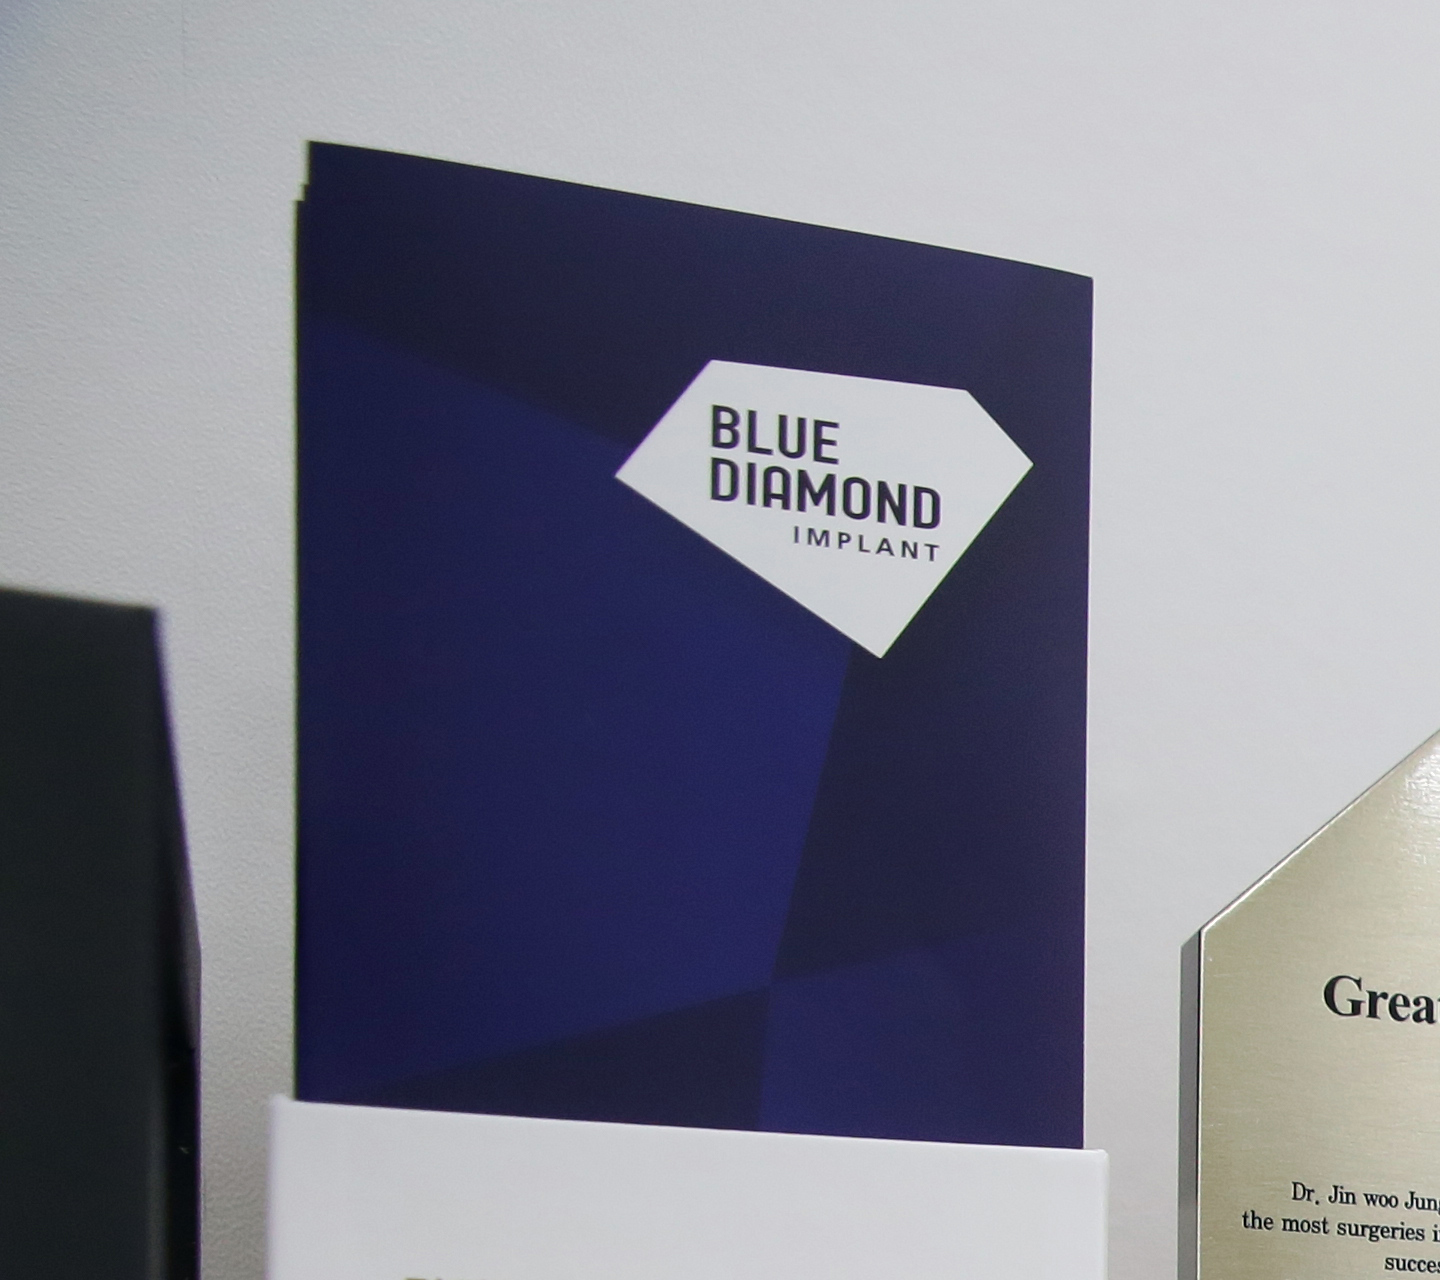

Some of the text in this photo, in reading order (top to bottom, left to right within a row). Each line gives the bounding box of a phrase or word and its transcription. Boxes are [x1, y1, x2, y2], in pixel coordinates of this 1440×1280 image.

[711, 404, 840, 465] BLUE
[710, 456, 941, 530] DIAMOND
[794, 525, 940, 562] IMPLANT
[1291, 1181, 1320, 1206] Dr.
[1328, 1184, 1357, 1205] Jin
[1363, 1192, 1399, 1209] woo
[1242, 1209, 1274, 1231] the
[1281, 1217, 1330, 1235] most
[1336, 1221, 1426, 1243] surgeries
